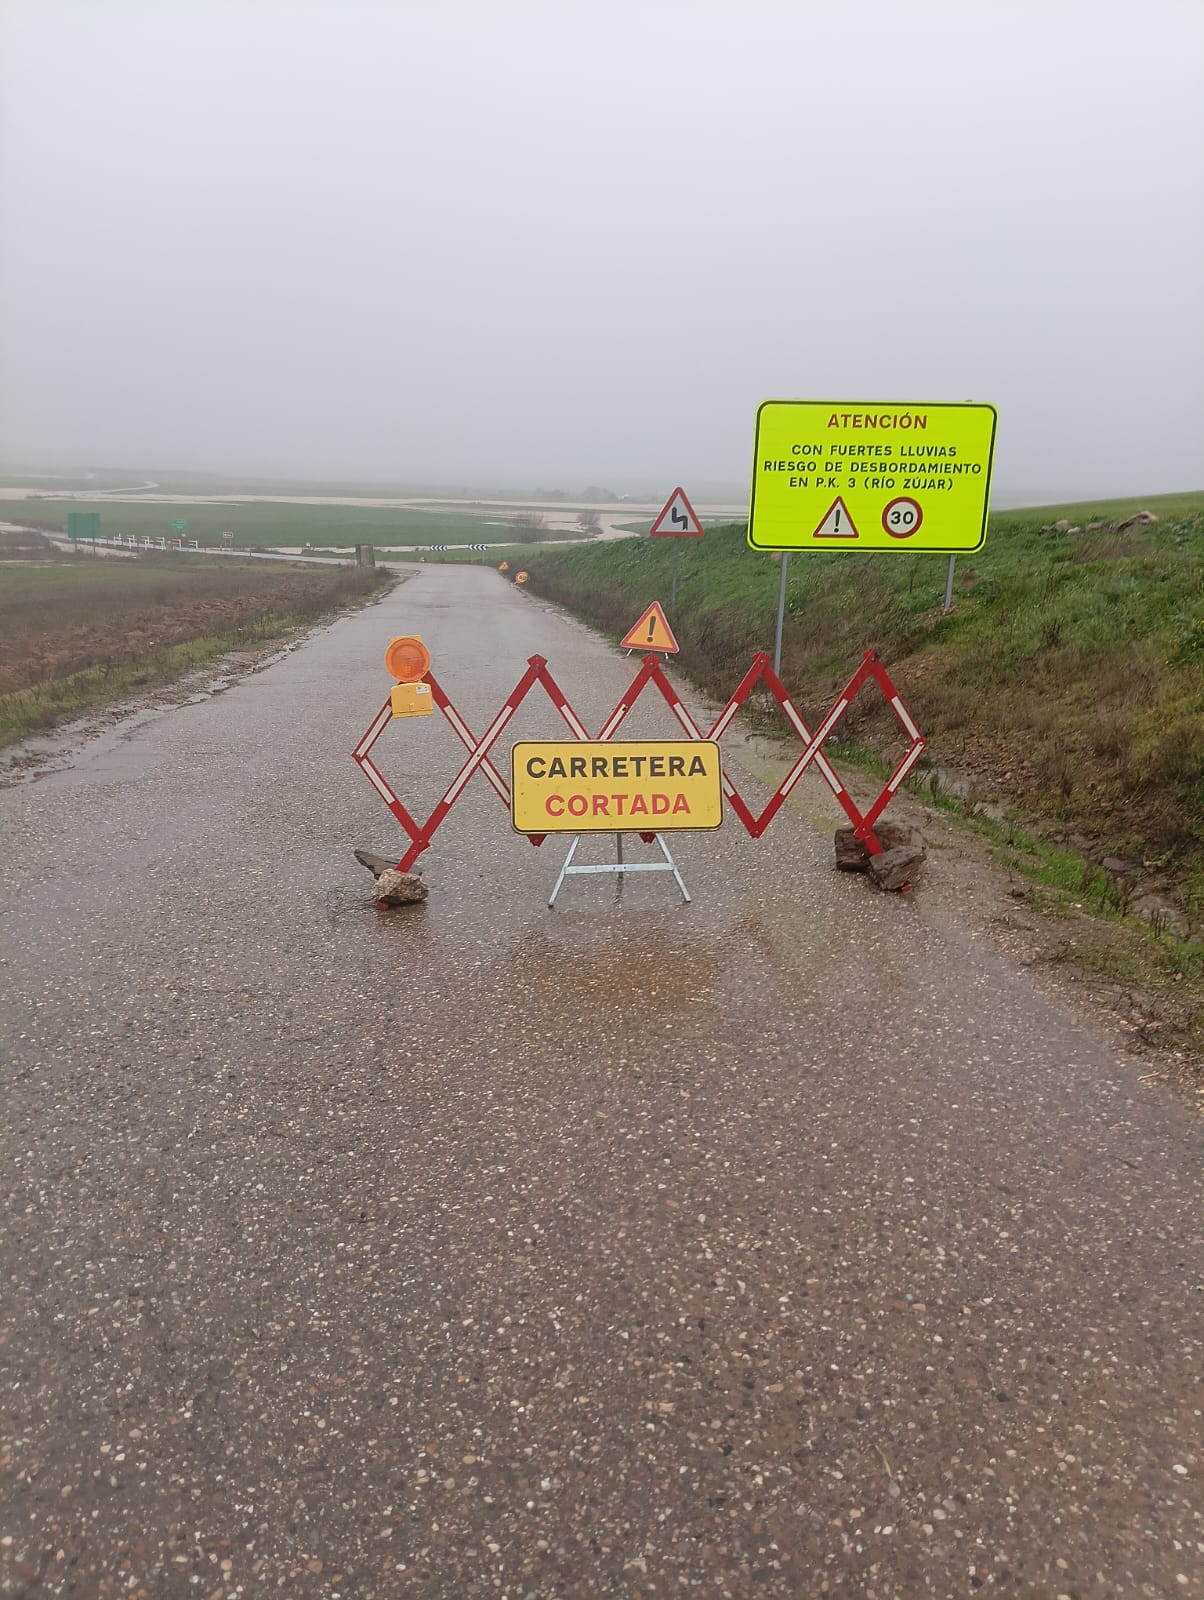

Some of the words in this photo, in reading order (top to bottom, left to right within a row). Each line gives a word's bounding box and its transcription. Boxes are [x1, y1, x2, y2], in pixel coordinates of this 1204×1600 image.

[827, 412, 927, 429] ATENCIÓN
[792, 445, 822, 455] CON
[830, 445, 892, 456] FUERTES
[900, 446, 957, 457] LLUVIAS
[764, 461, 817, 472] RIESGO
[825, 462, 843, 472] DE
[851, 462, 981, 474] DESBORDAMIENTO
[789, 477, 808, 487] EN
[816, 478, 840, 488] P.K.
[848, 478, 856, 488] 3
[864, 476, 895, 490] (RÍO
[903, 477, 953, 490] ZÚJAR)
[890, 511, 913, 525] 30
[527, 756, 707, 778] CARRETERA
[545, 794, 691, 816] CORTADA
